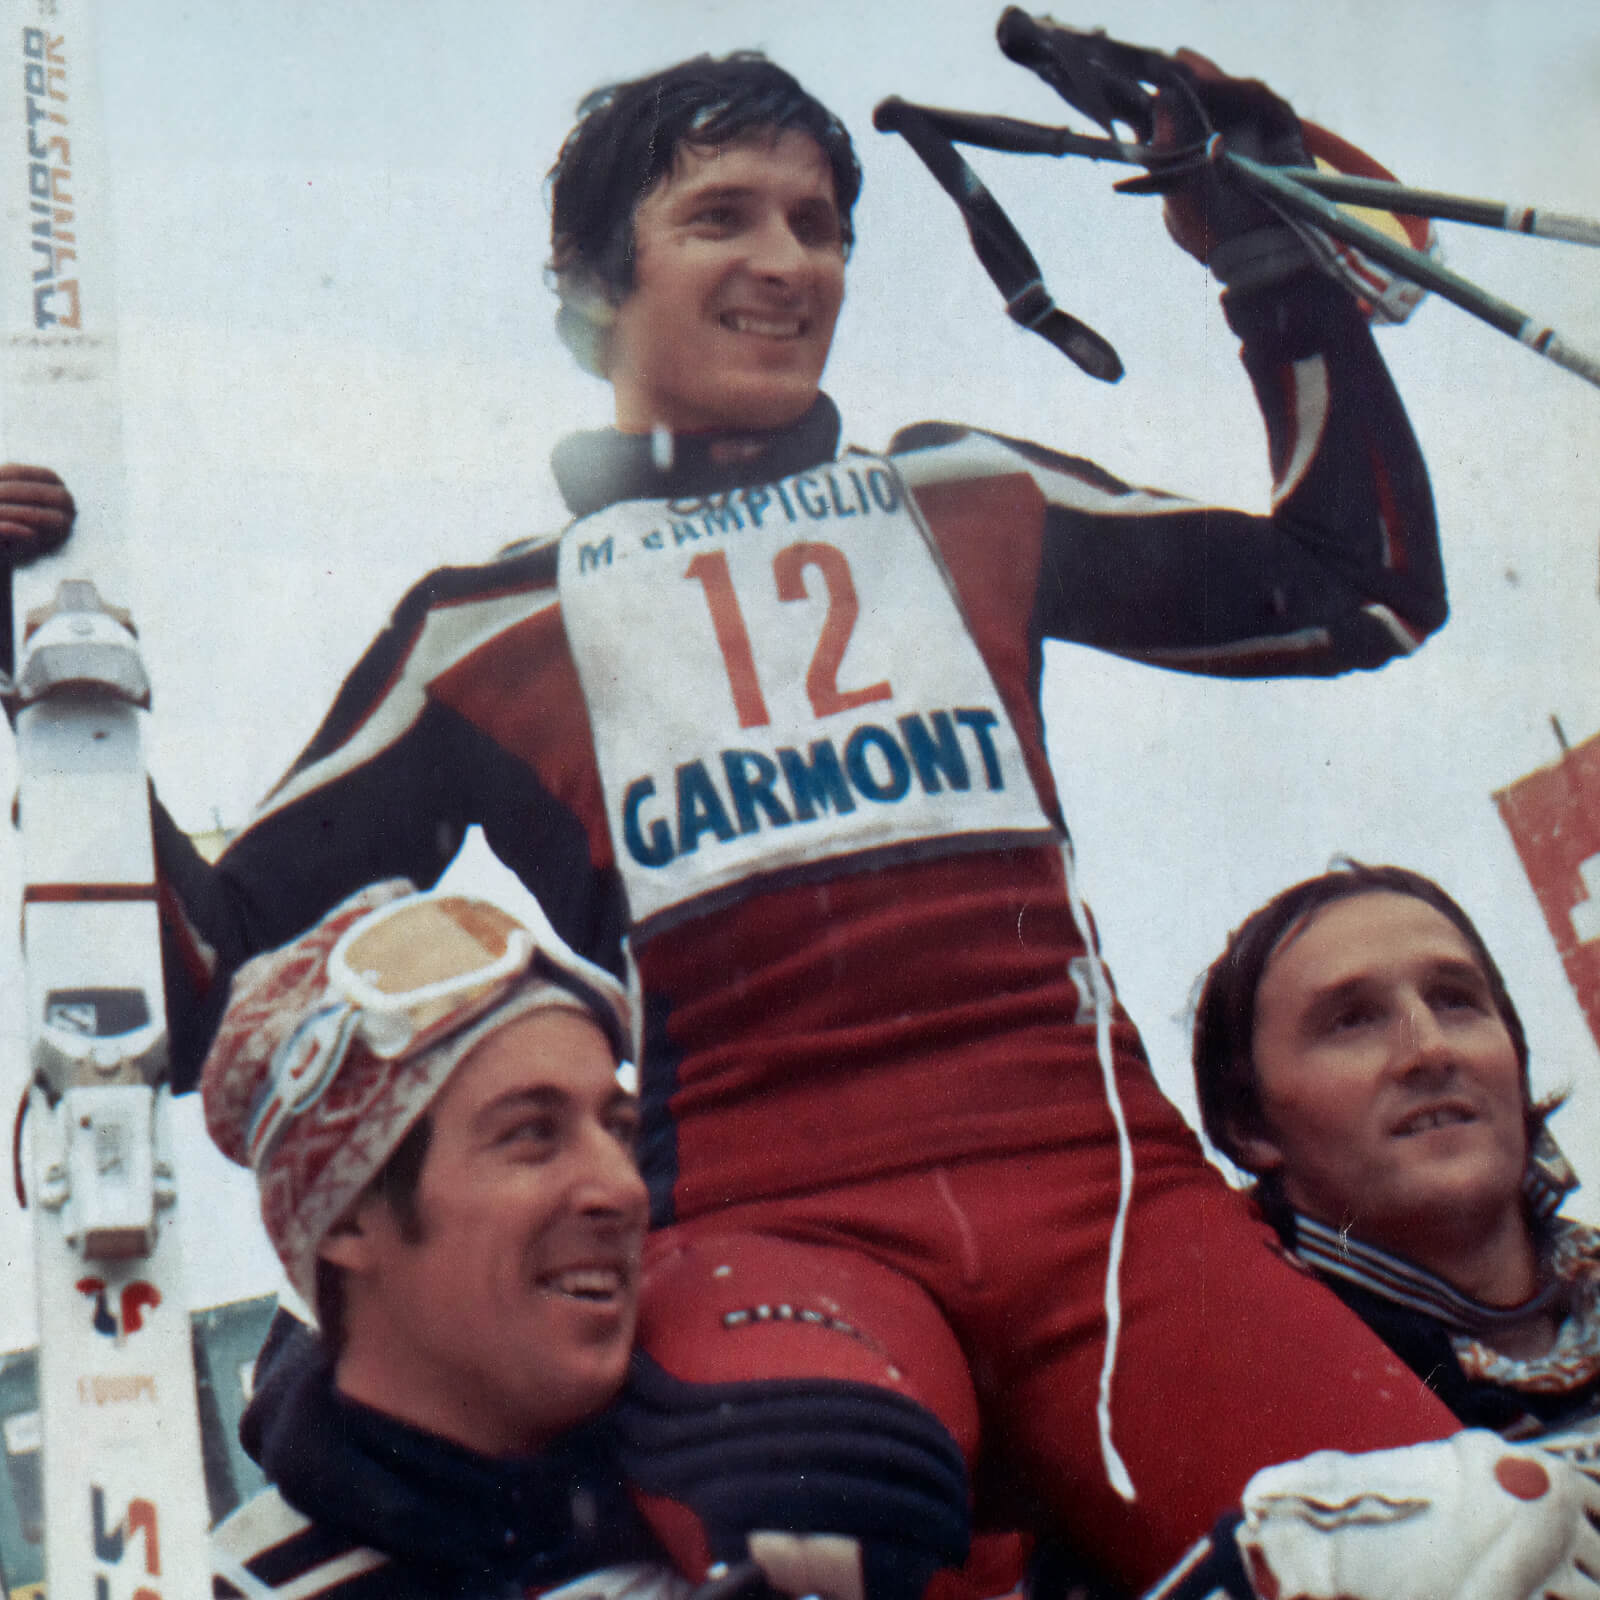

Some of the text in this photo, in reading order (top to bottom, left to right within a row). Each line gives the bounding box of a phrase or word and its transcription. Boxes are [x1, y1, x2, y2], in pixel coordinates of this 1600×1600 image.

[24, 26, 81, 330] DYNASTAR
[683, 540, 893, 729] 12
[622, 707, 1005, 869] GARMONT
